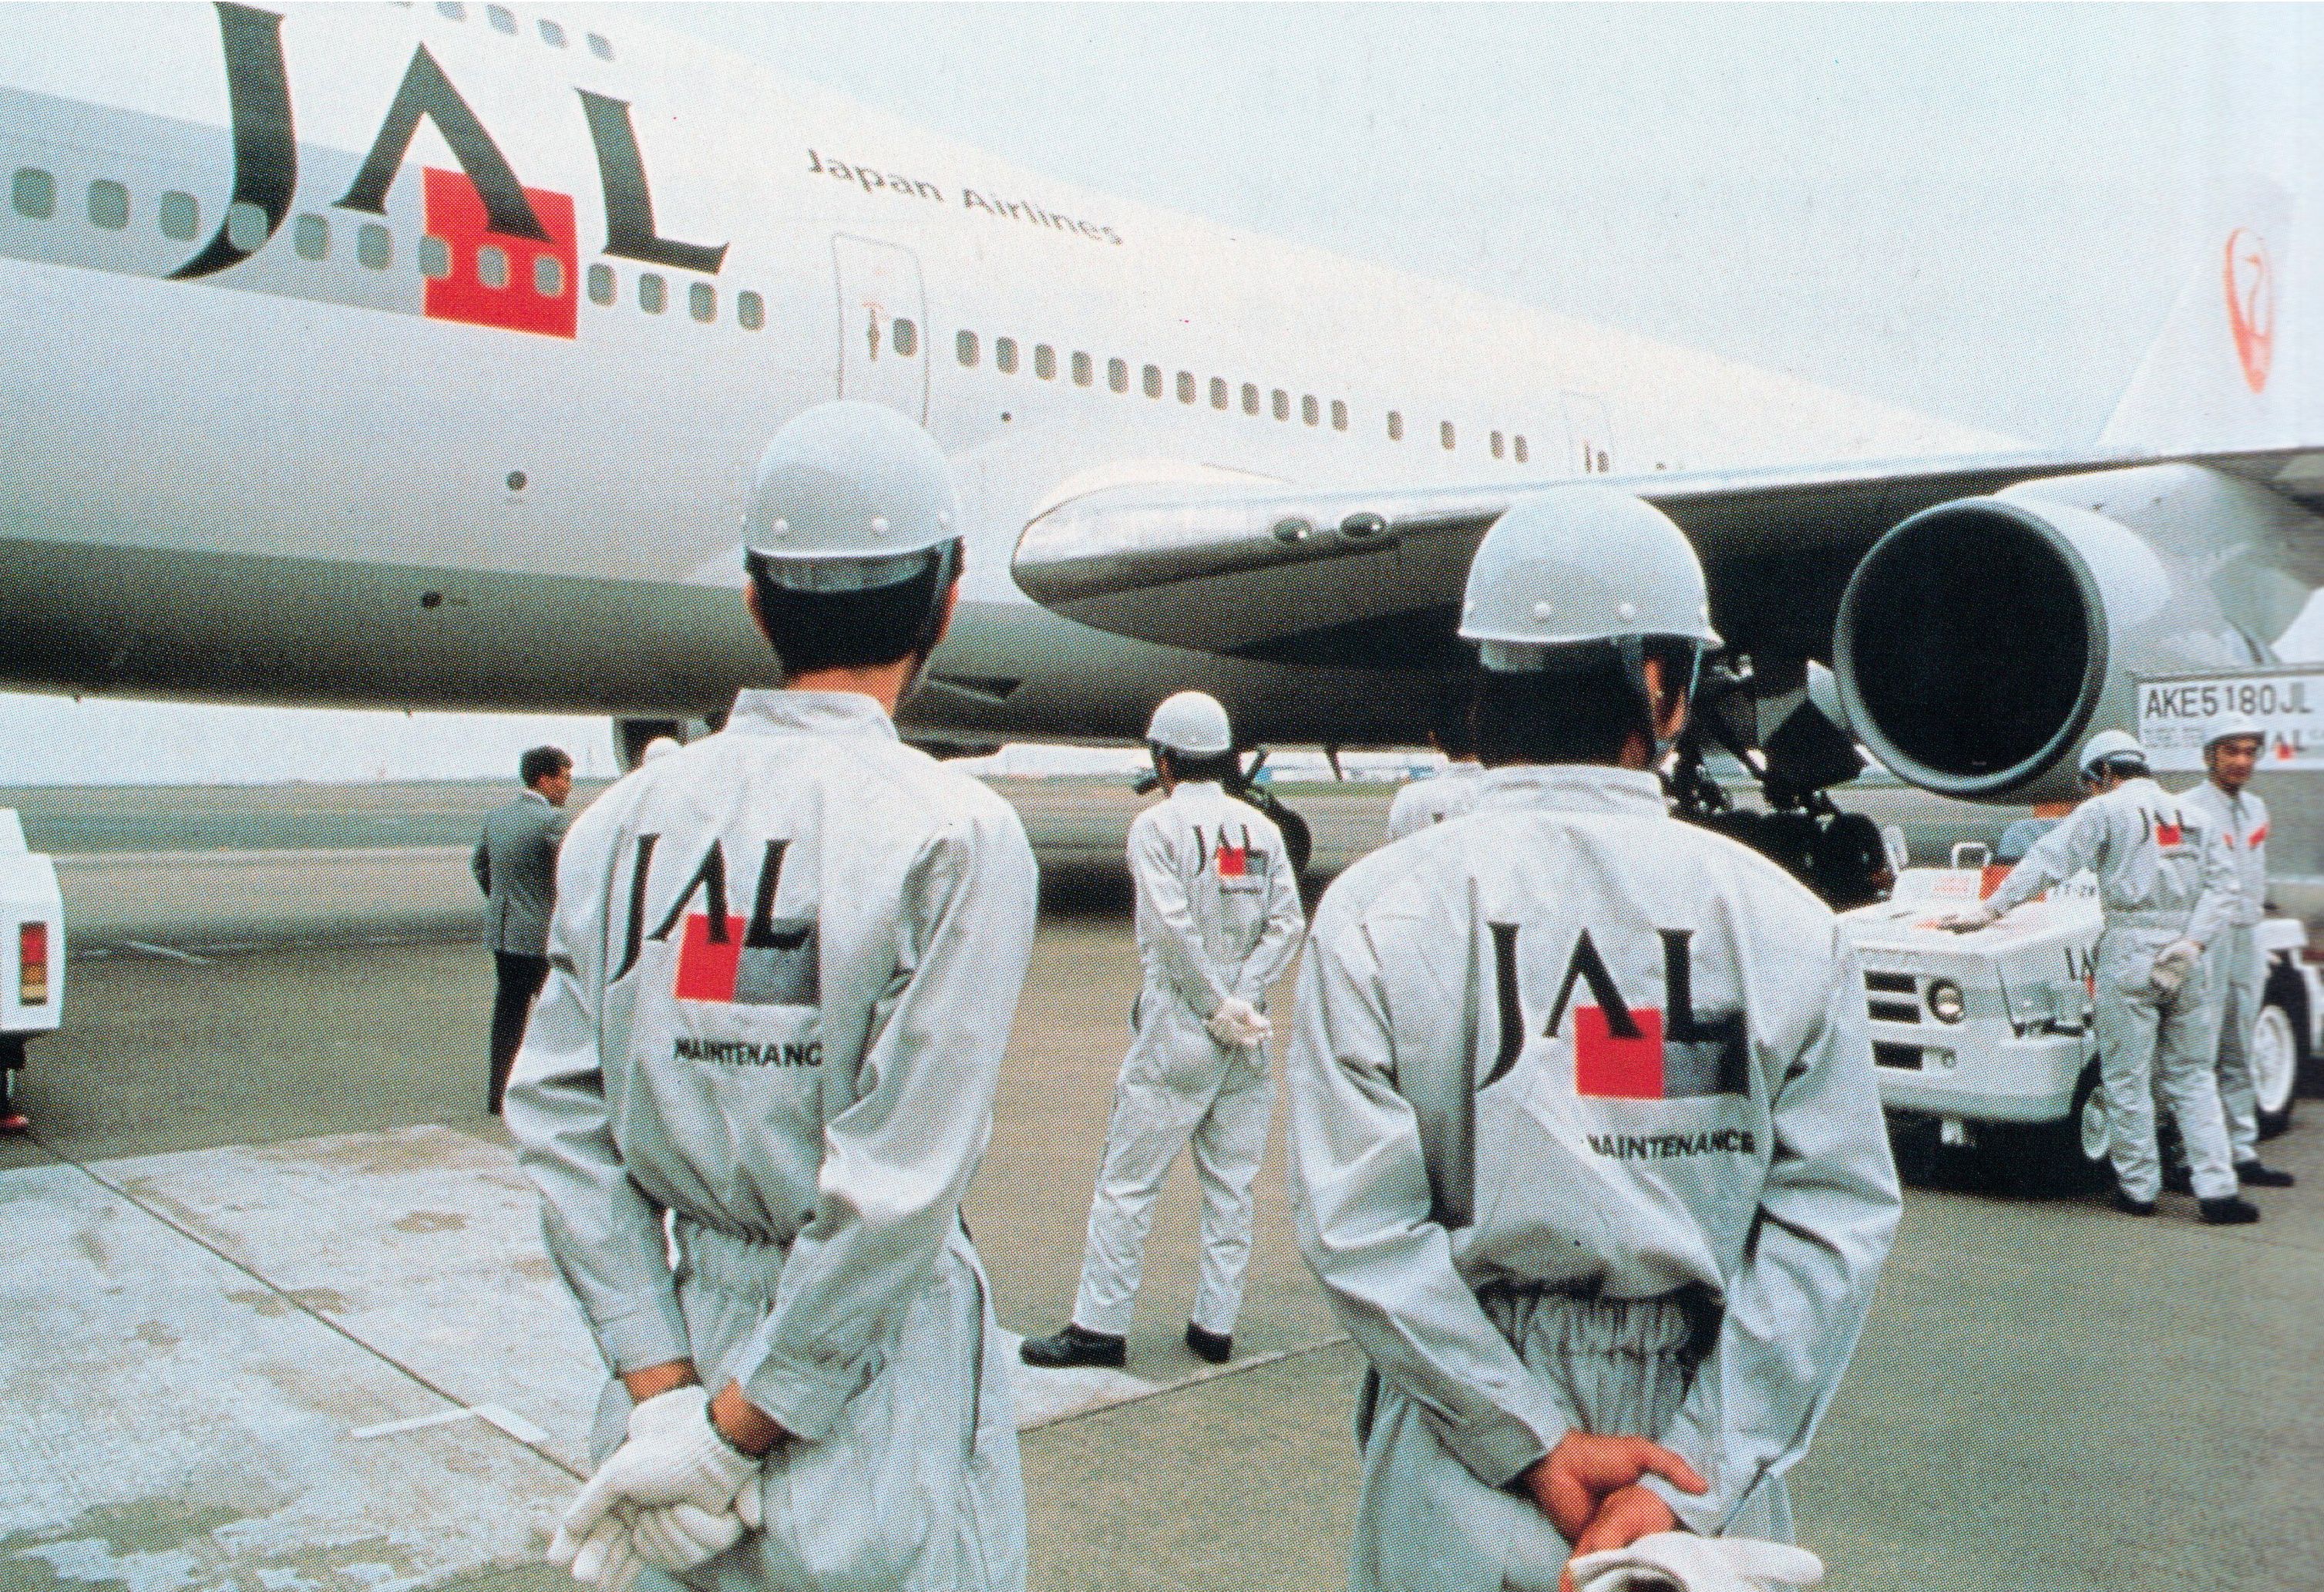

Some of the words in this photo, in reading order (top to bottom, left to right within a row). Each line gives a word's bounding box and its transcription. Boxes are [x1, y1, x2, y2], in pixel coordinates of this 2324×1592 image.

[166, 1, 730, 280] JAL
[807, 147, 945, 203] Japan
[961, 187, 1124, 246] Airlines
[605, 833, 812, 984] JAL
[673, 1038, 823, 1068] MAINTENANC
[1475, 920, 1745, 1092] JAL
